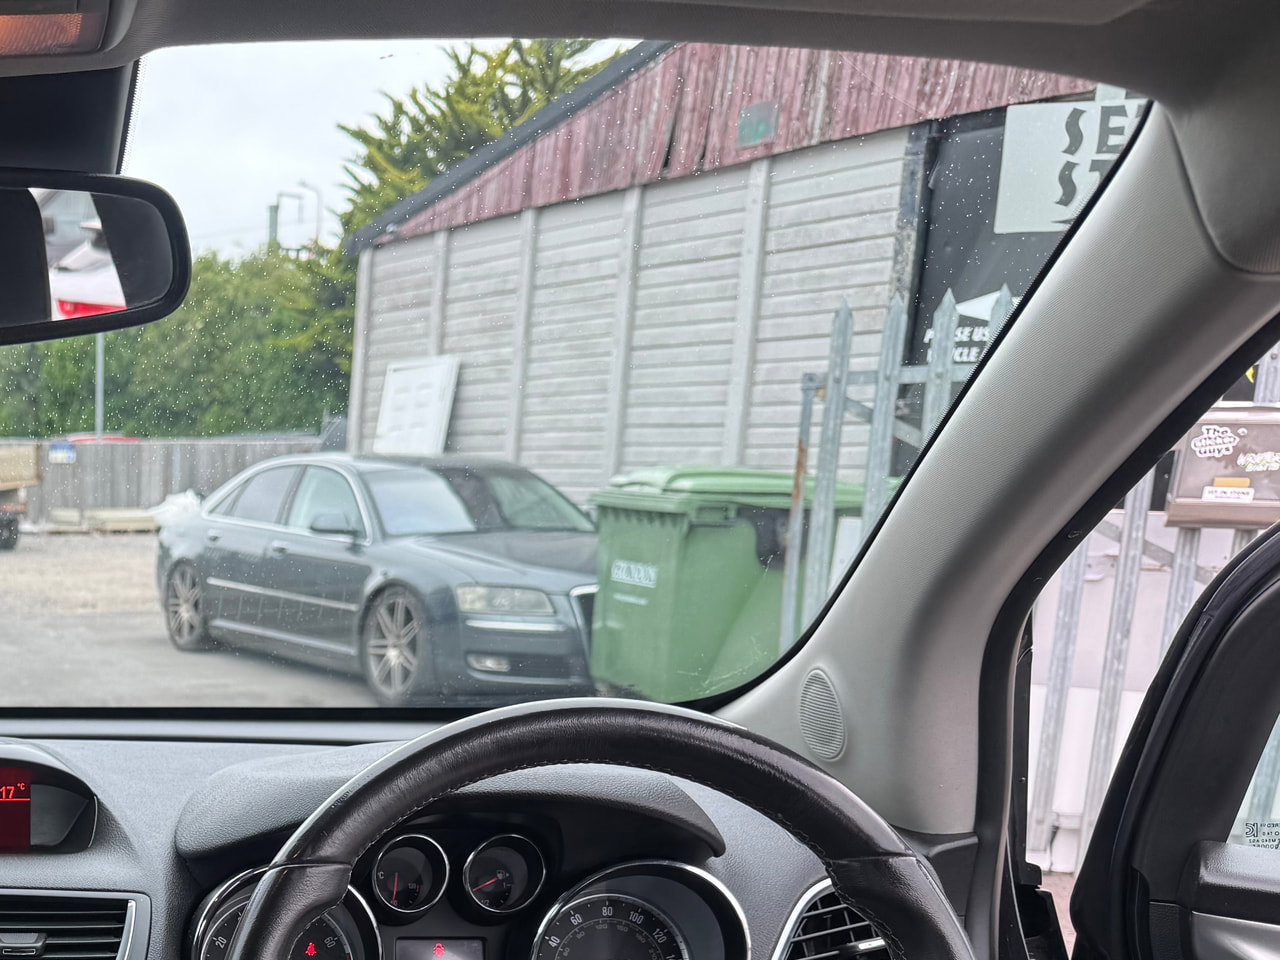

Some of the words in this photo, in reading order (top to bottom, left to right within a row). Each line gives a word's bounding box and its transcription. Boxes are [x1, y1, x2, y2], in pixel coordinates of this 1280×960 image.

[1061, 104, 1148, 156] SE
[602, 906, 613, 916] 80
[570, 913, 583, 926] 60
[629, 911, 644, 925] 100
[323, 936, 335, 948] 60
[548, 935, 560, 948] 40
[652, 928, 667, 943] 120
[215, 936, 227, 949] 20
